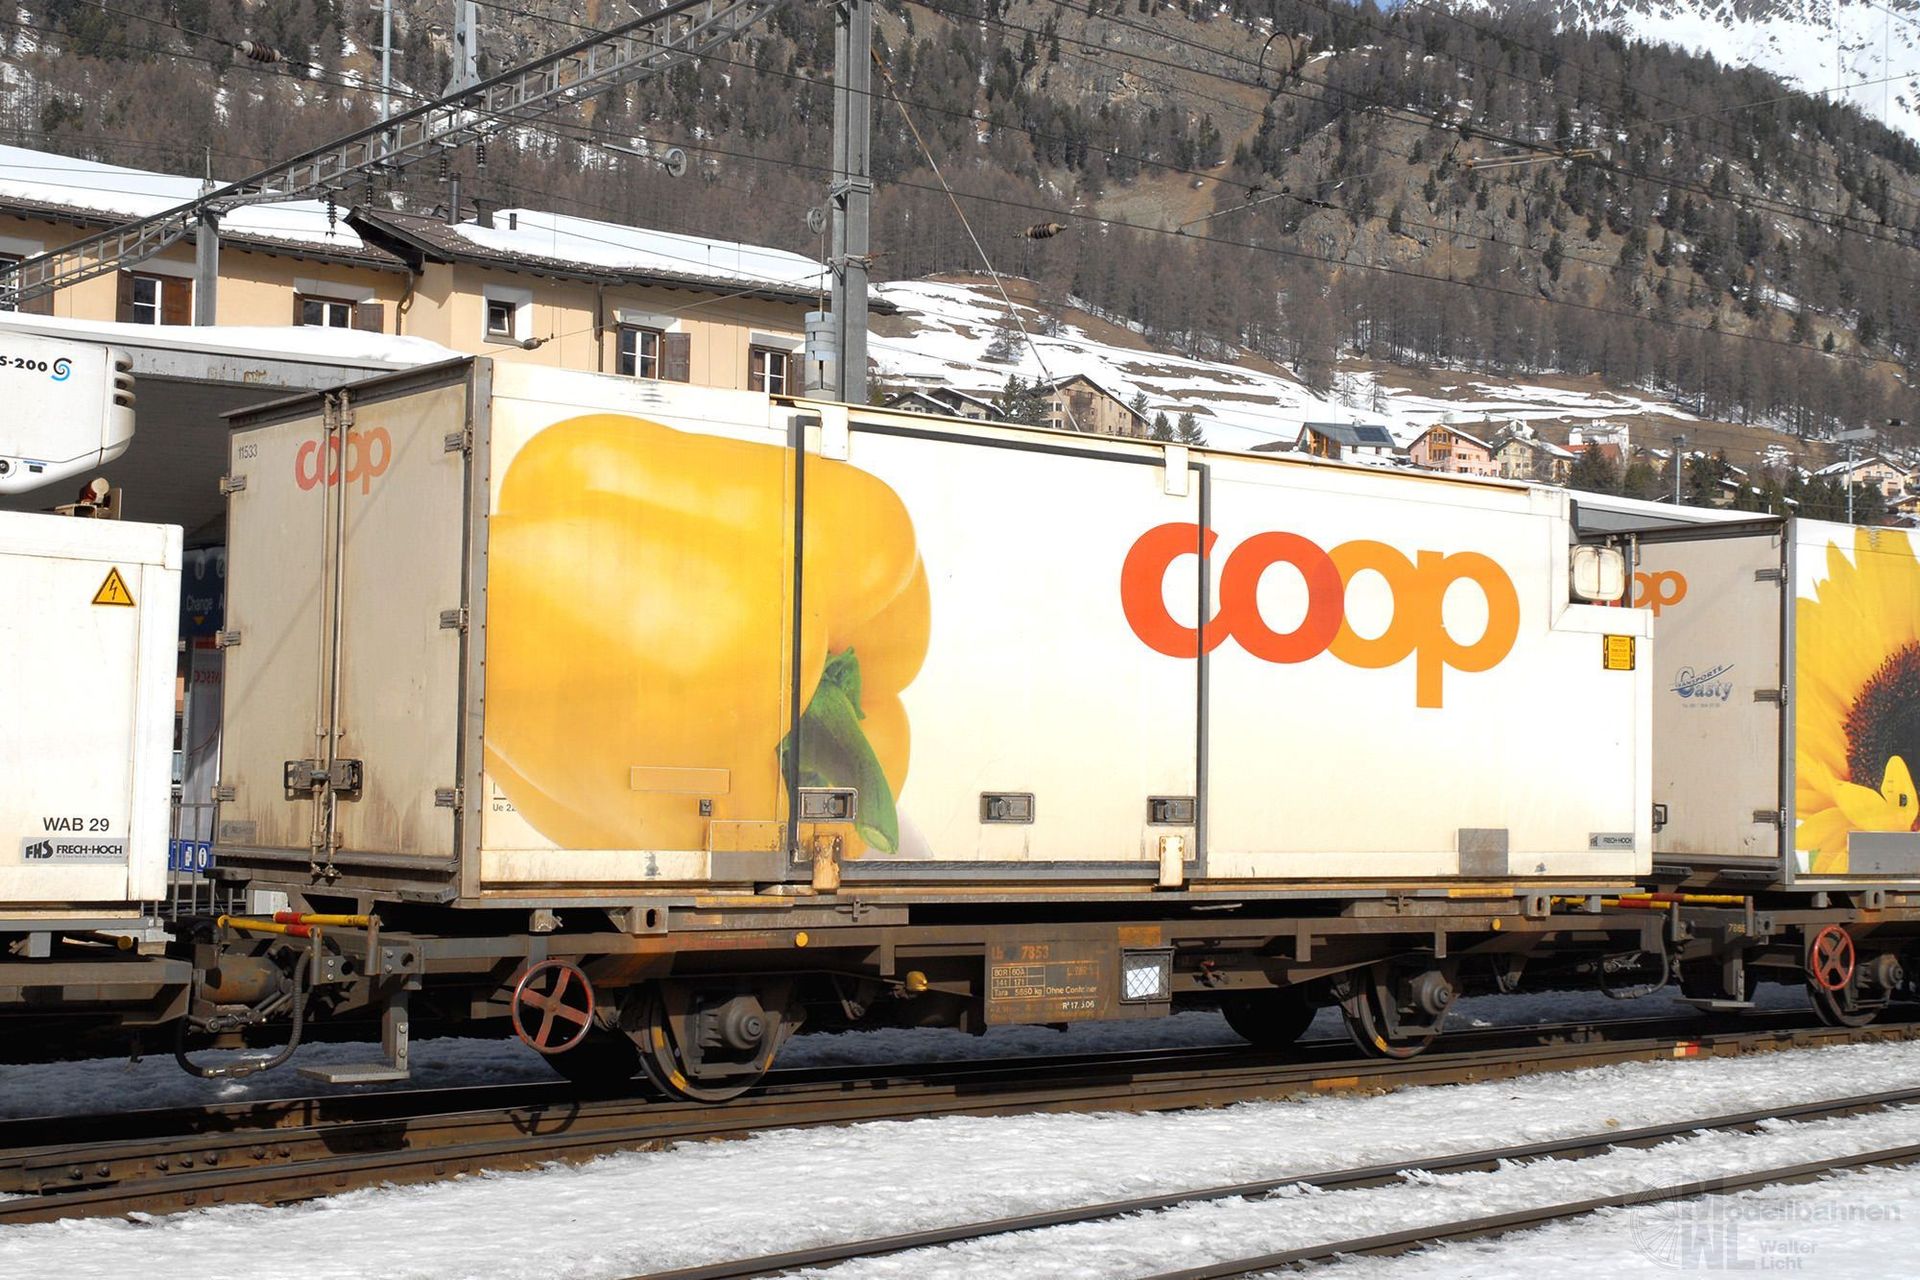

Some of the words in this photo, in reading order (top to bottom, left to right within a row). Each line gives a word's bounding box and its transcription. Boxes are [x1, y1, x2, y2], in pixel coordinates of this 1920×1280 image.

[238, 443, 258, 460] 11533
[295, 427, 392, 495] coop
[1121, 522, 1520, 708] coop
[43, 817, 83, 831] WAB
[89, 818, 109, 831] 29
[25, 840, 53, 859] FHS
[56, 845, 122, 855] FRECH-HOCH
[1046, 986, 1065, 995] Ohne
